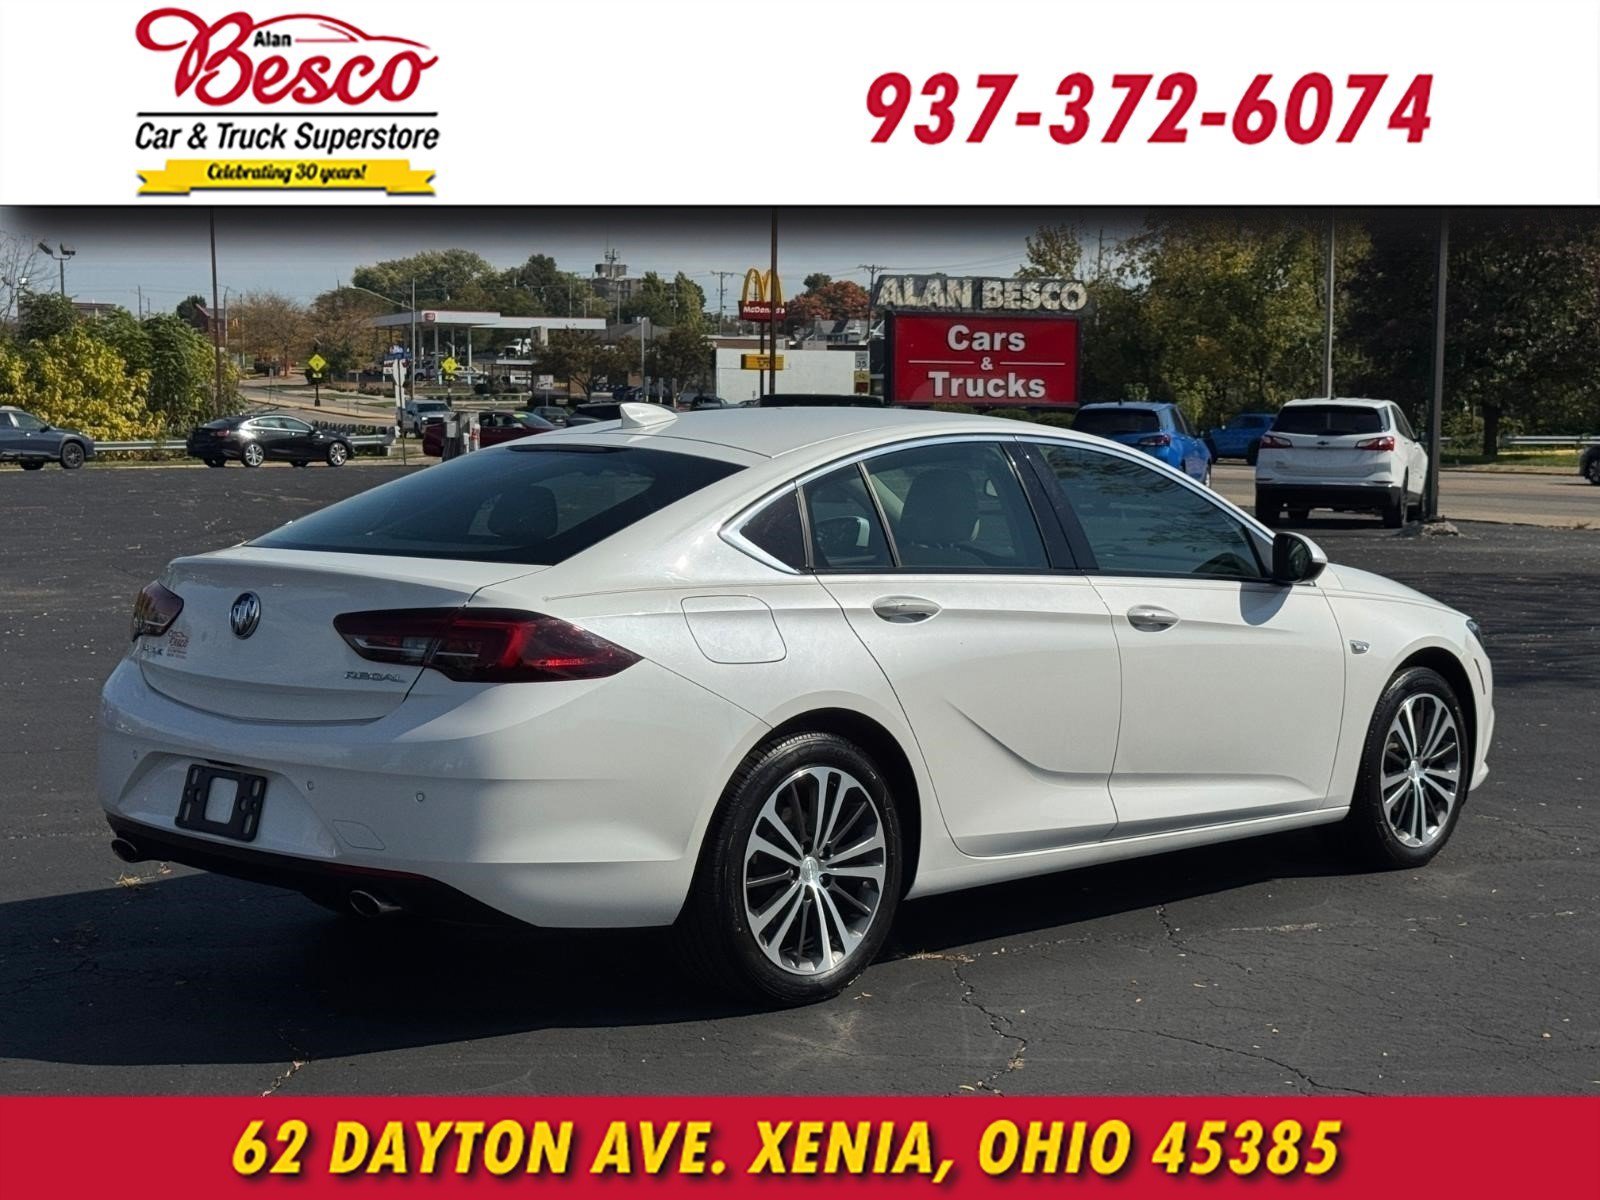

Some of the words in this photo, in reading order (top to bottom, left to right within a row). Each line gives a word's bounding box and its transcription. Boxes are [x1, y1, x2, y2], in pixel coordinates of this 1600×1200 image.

[876, 276, 973, 309] ALAN
[981, 279, 1088, 311] BESCO
[947, 325, 1025, 351] Cars
[980, 356, 994, 371] &
[928, 371, 1046, 398] Trucks
